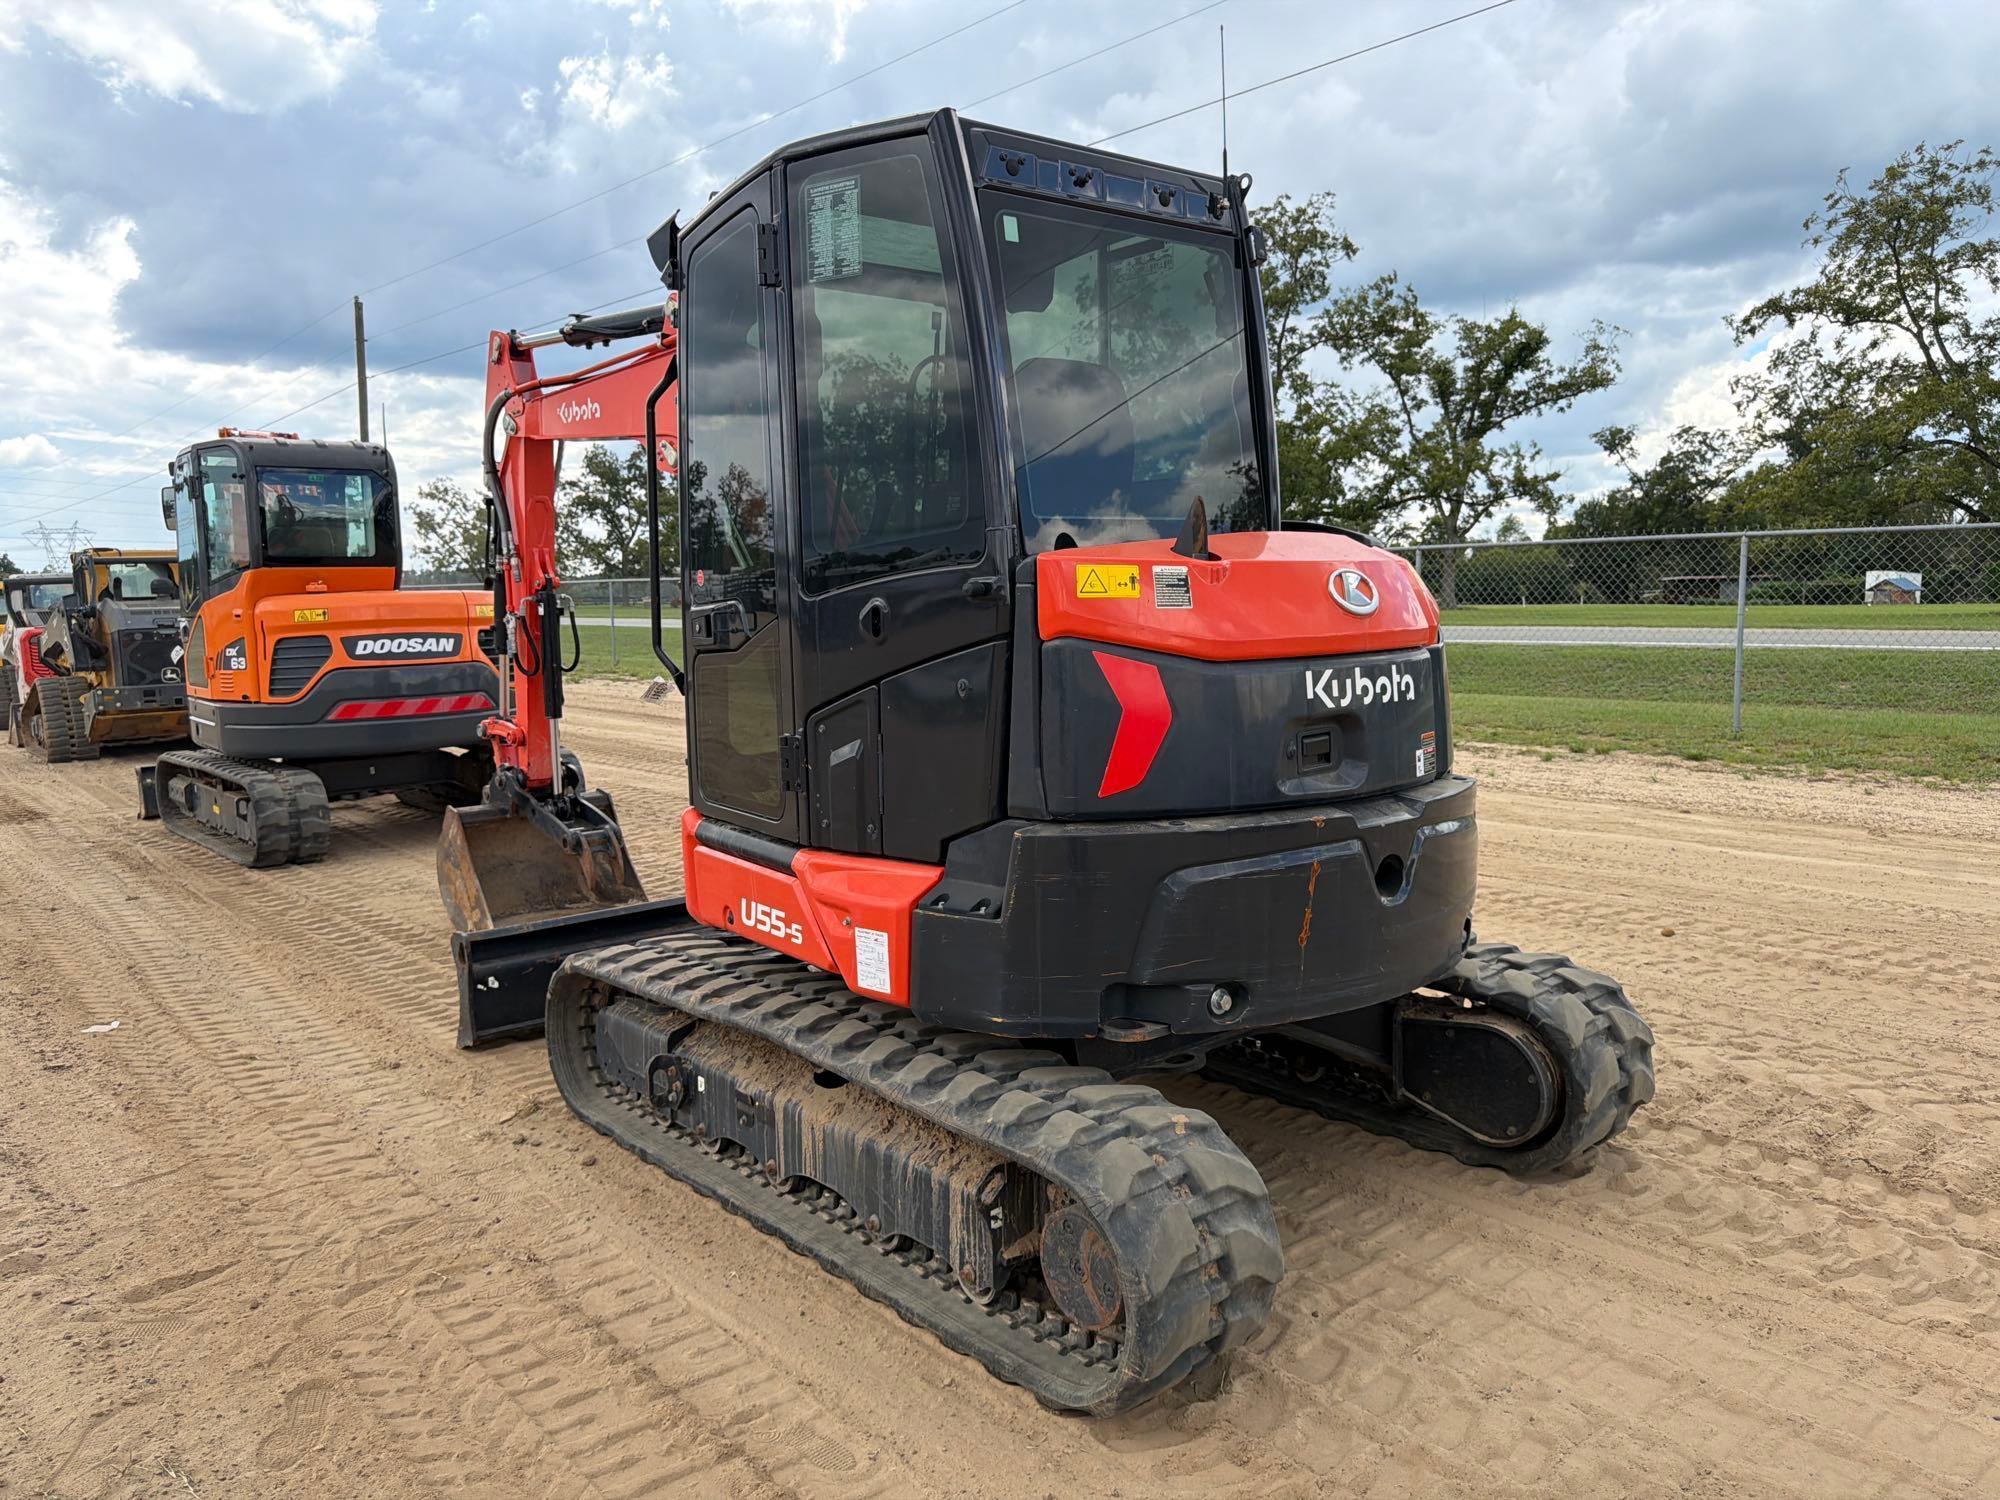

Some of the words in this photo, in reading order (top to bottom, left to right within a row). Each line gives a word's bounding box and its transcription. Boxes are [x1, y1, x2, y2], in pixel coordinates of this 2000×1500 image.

[556, 397, 601, 424] Kubota
[355, 638, 454, 655] DOOSAN
[230, 656, 246, 669] 63
[1305, 664, 1415, 708] Kubota
